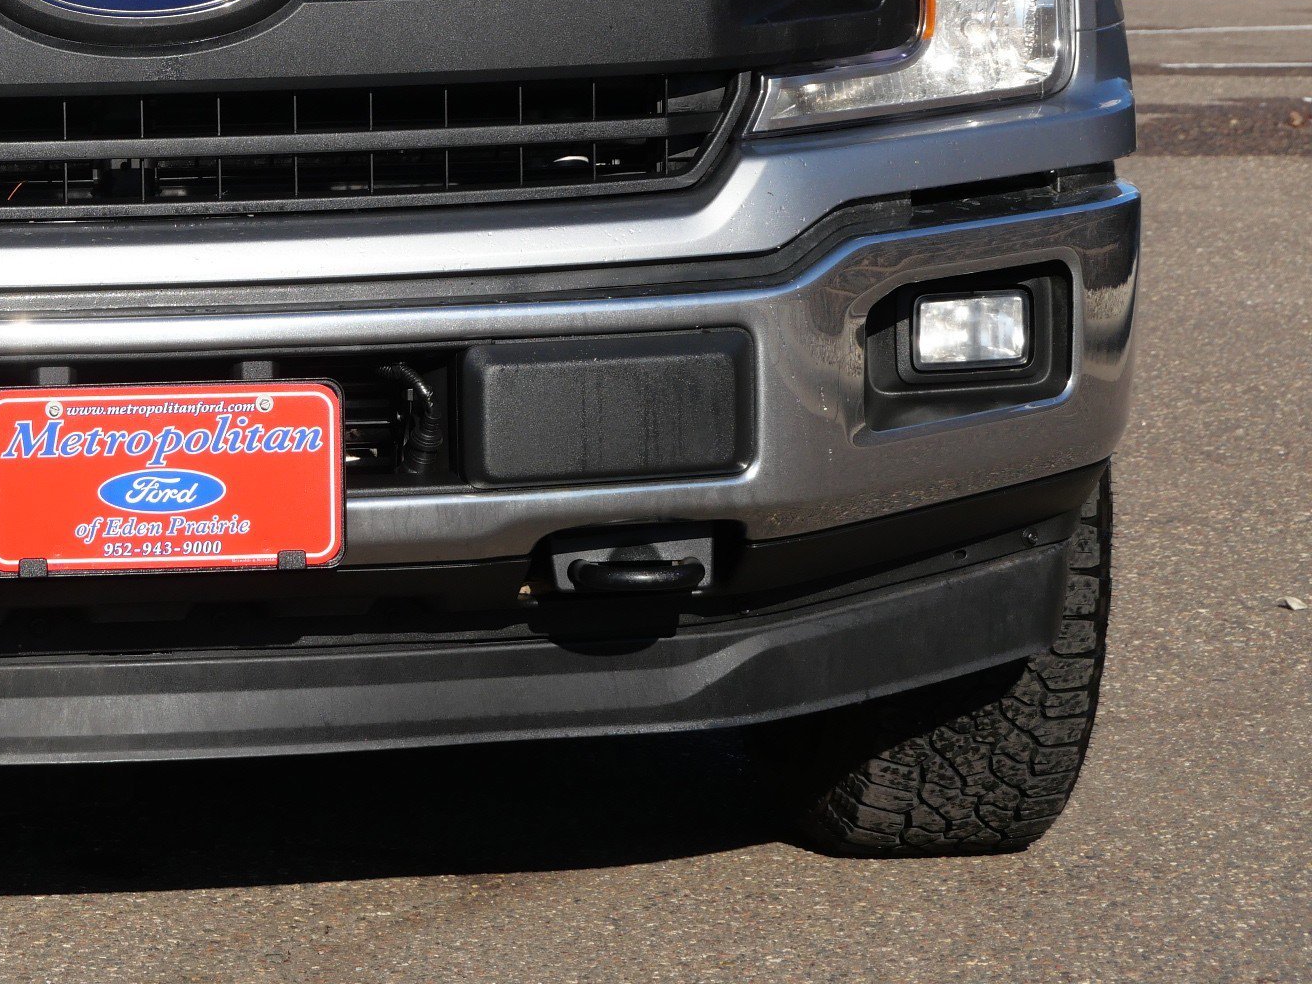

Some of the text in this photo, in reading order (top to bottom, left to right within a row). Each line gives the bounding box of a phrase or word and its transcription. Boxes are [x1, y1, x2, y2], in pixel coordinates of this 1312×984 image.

[66, 401, 256, 417] www.metropolitanford.com
[0, 414, 323, 467] Metropolitan
[125, 476, 198, 504] Ford
[75, 514, 250, 543] of Eden Prairie
[103, 540, 222, 557] 952-943-9000
